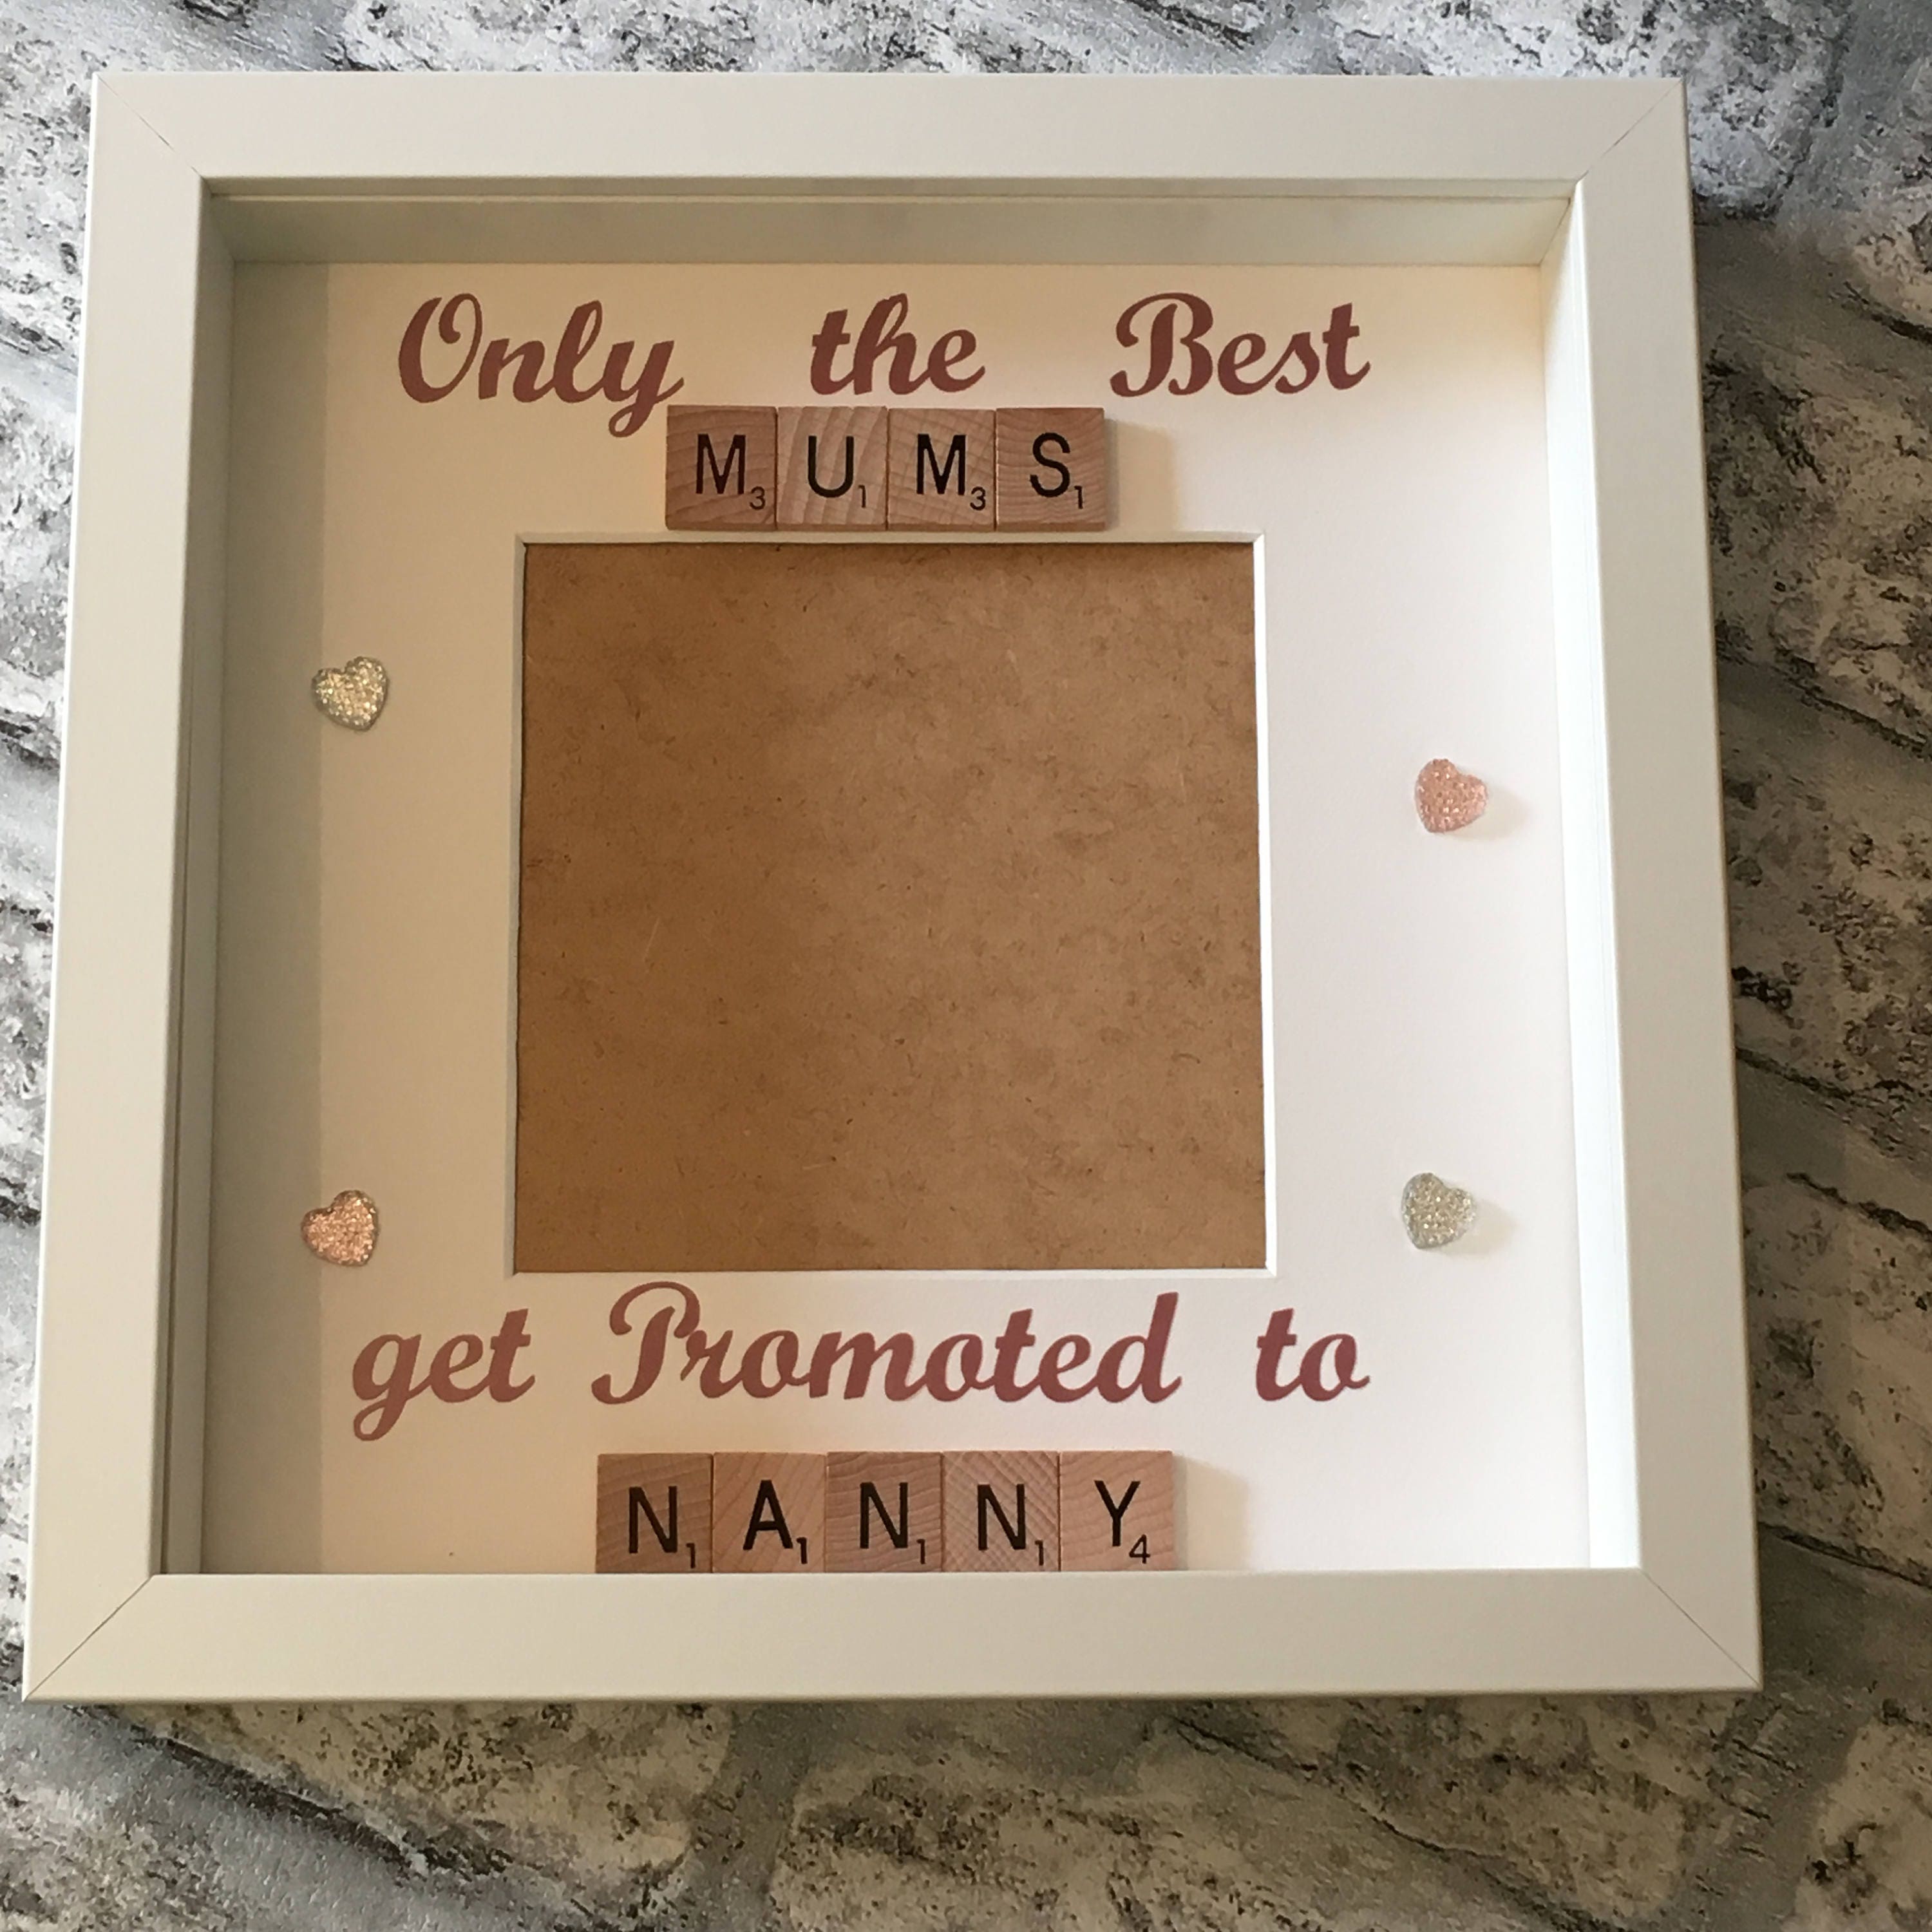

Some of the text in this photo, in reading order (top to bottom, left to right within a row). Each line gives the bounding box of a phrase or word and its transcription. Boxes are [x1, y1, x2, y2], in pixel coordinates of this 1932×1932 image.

[399, 292, 1371, 437] Only the Best
[352, 1280, 1370, 1442] get Promoted to
